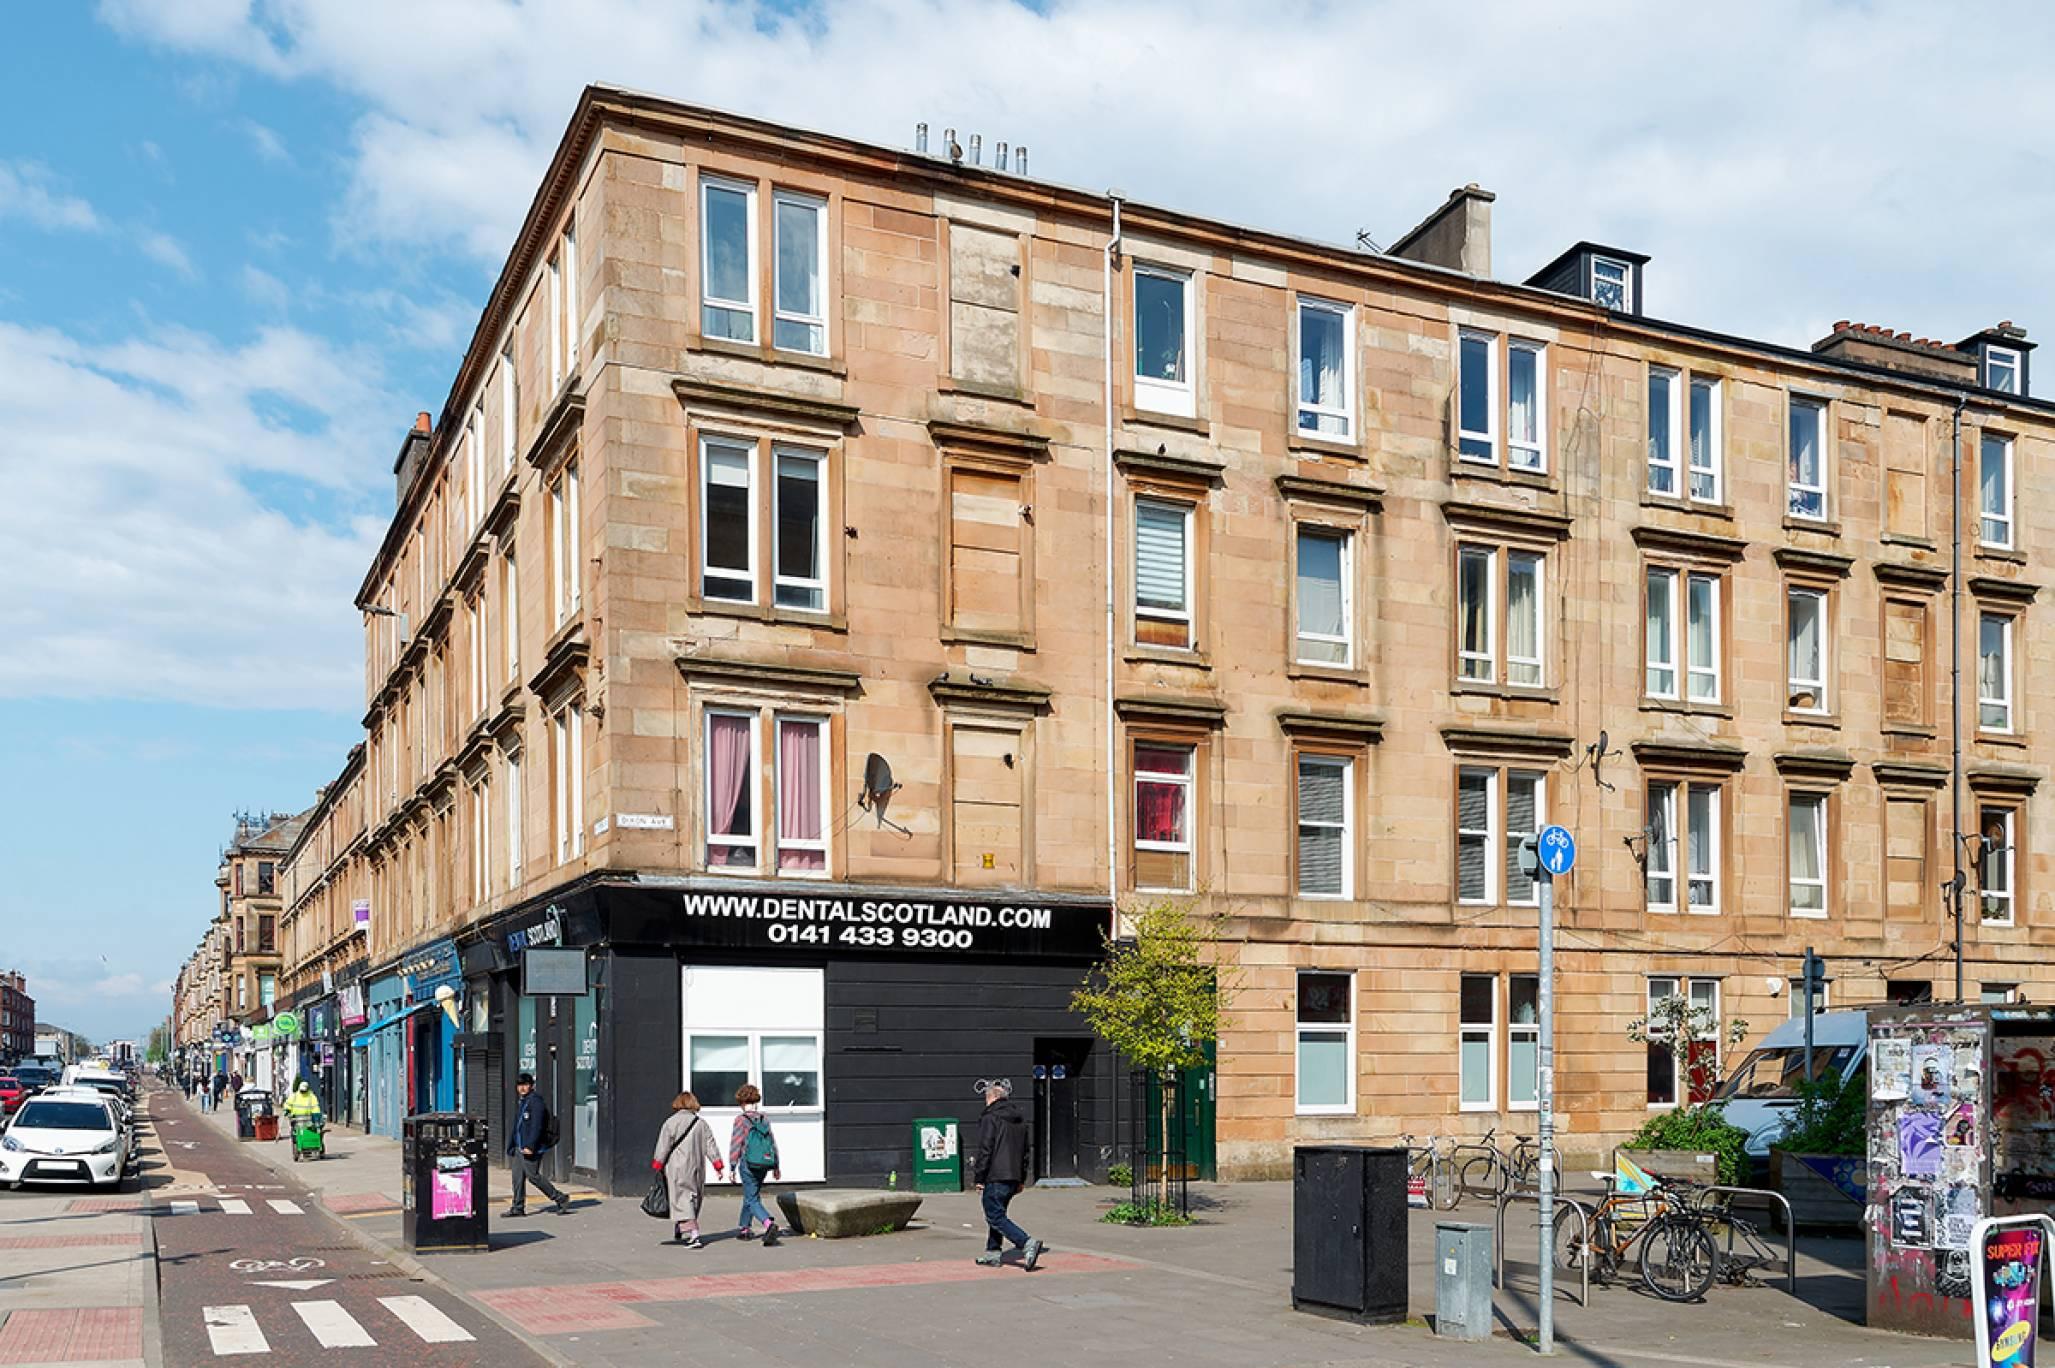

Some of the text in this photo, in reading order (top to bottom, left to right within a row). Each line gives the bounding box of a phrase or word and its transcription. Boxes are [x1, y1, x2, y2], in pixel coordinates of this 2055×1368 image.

[683, 894, 1052, 929] WWW.DENTALSCOTLAND.COM
[768, 923, 973, 949] 0141 433 9300
[1986, 1242, 2021, 1260] SUPER
